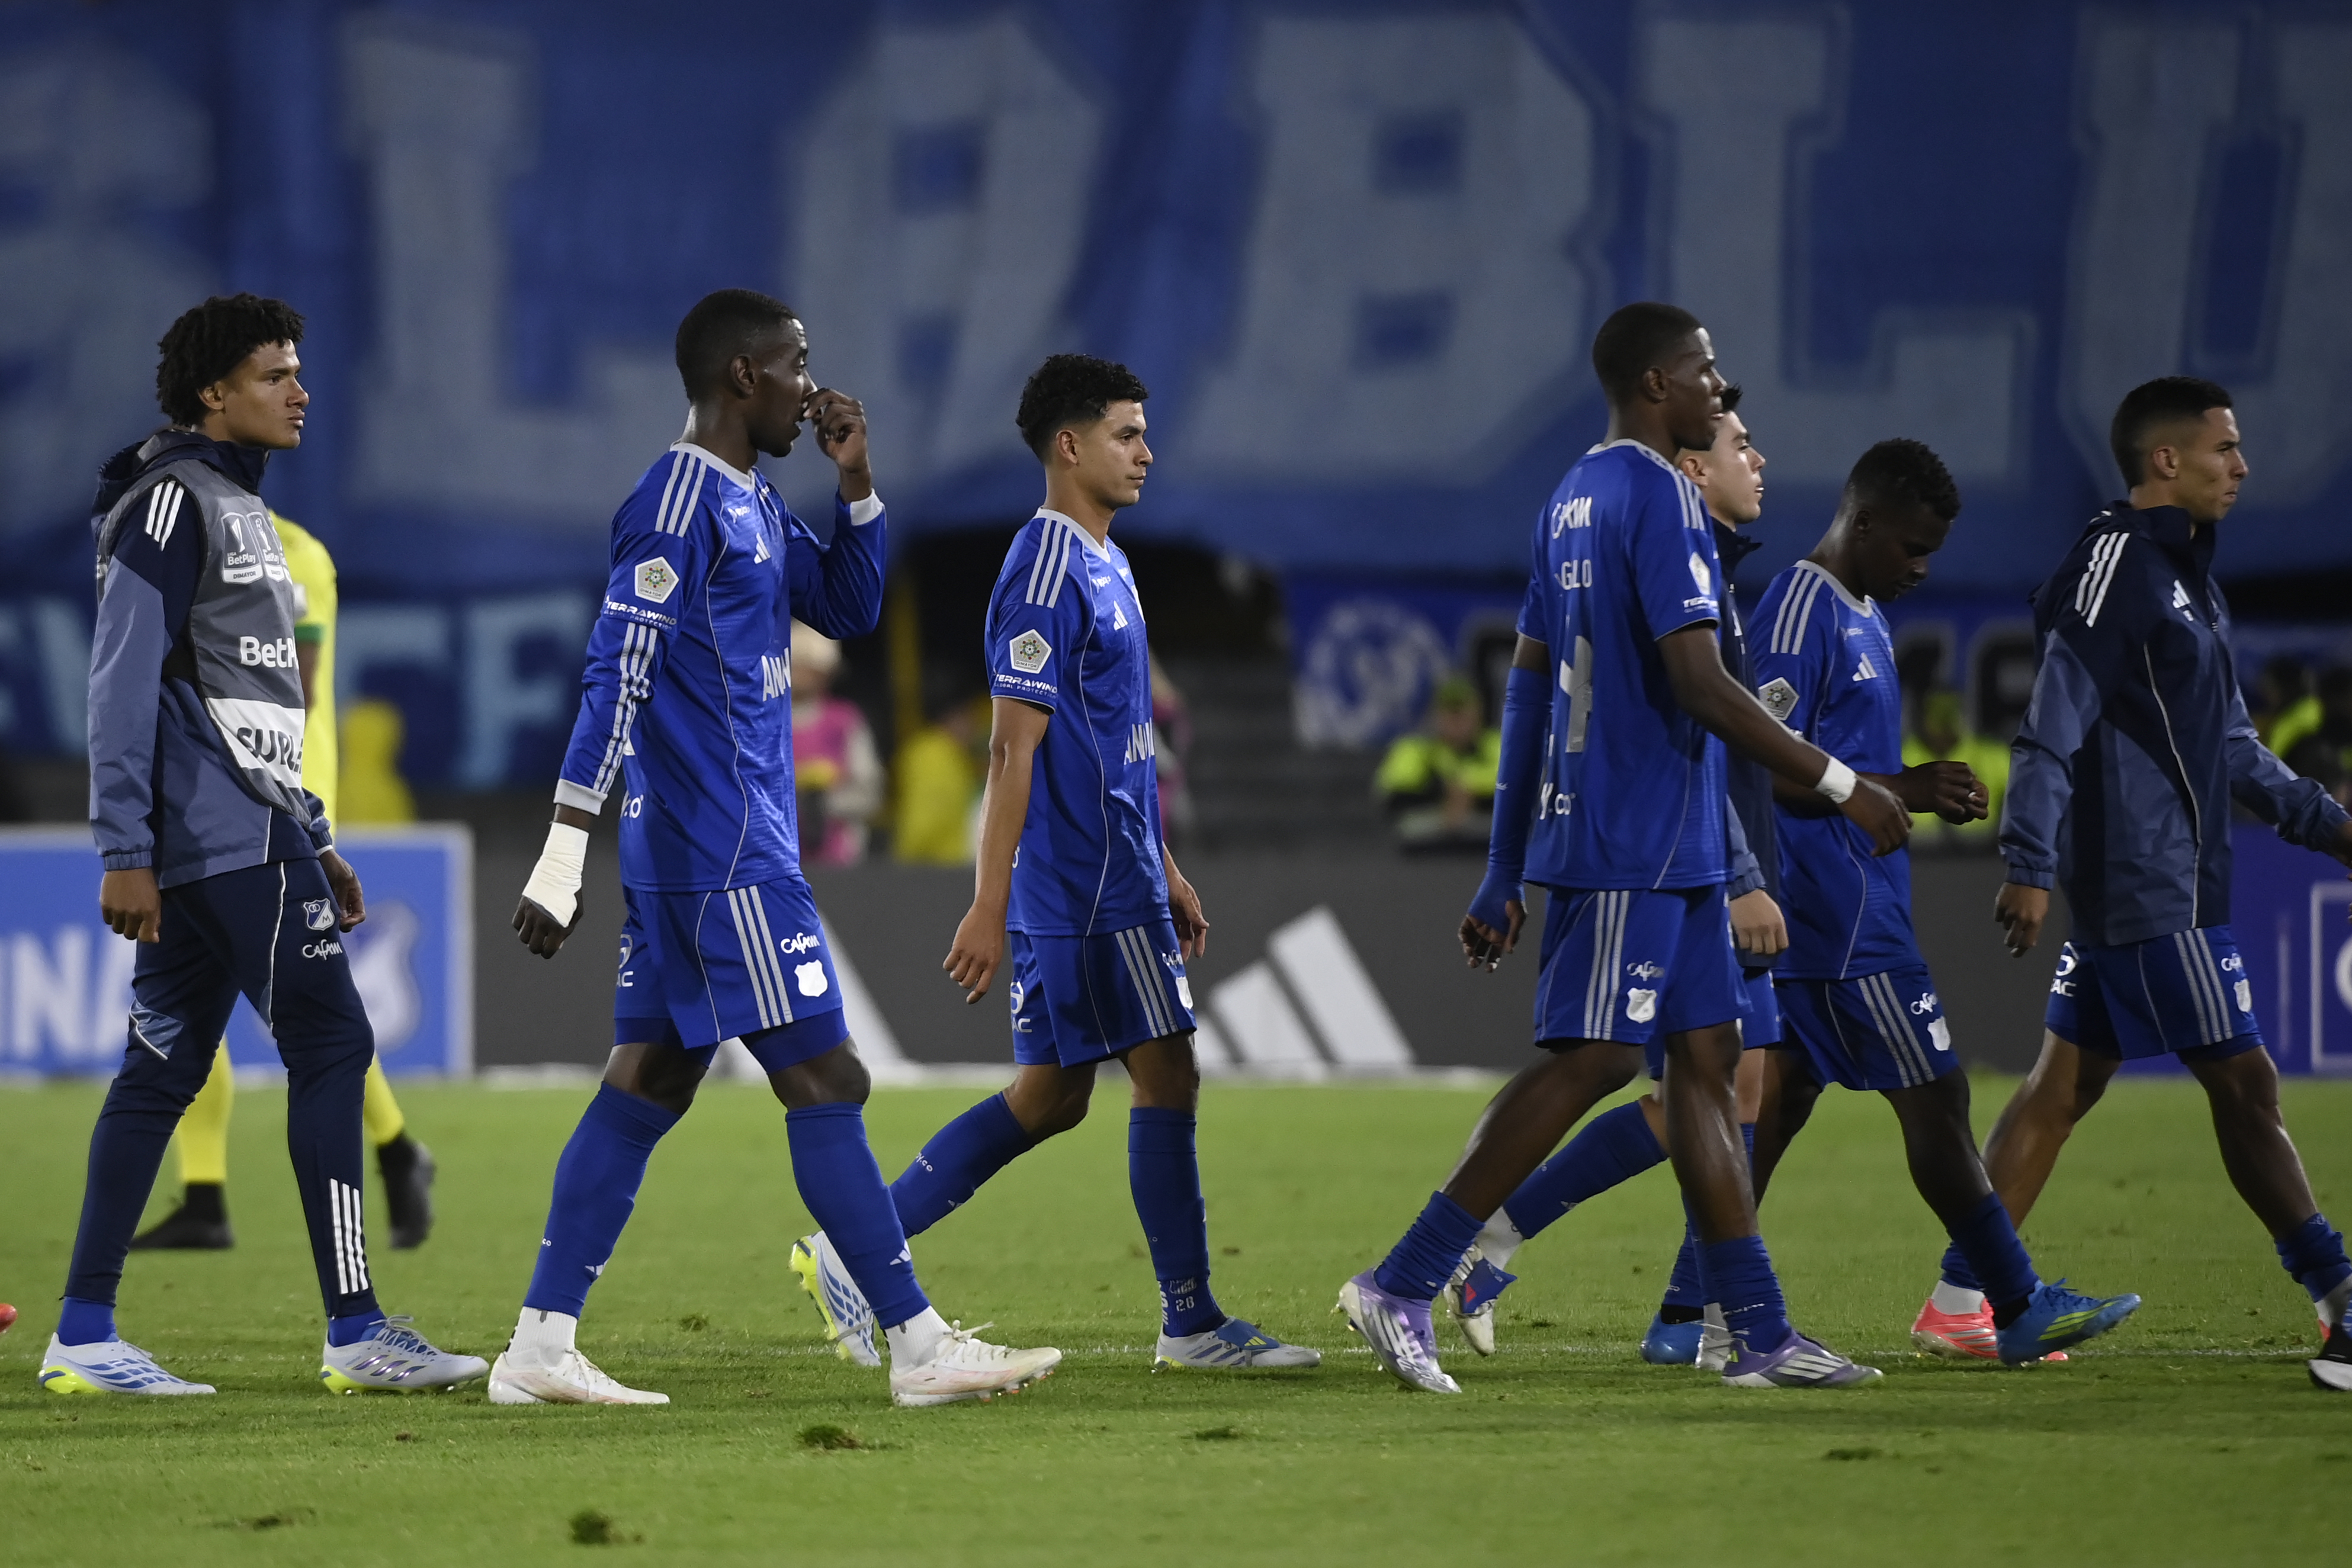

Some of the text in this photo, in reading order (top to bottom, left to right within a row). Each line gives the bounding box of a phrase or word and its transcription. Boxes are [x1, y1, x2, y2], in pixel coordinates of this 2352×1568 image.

[227, 553, 256, 565] BetPlay
[233, 571, 256, 579] DIMAYOR
[605, 600, 678, 626] TERRAWIND
[630, 615, 672, 631] PROTECTION
[1016, 660, 1038, 669] DIMAYOR
[995, 674, 1058, 694] TERRAWIND
[1017, 685, 1058, 699] PROTECTION
